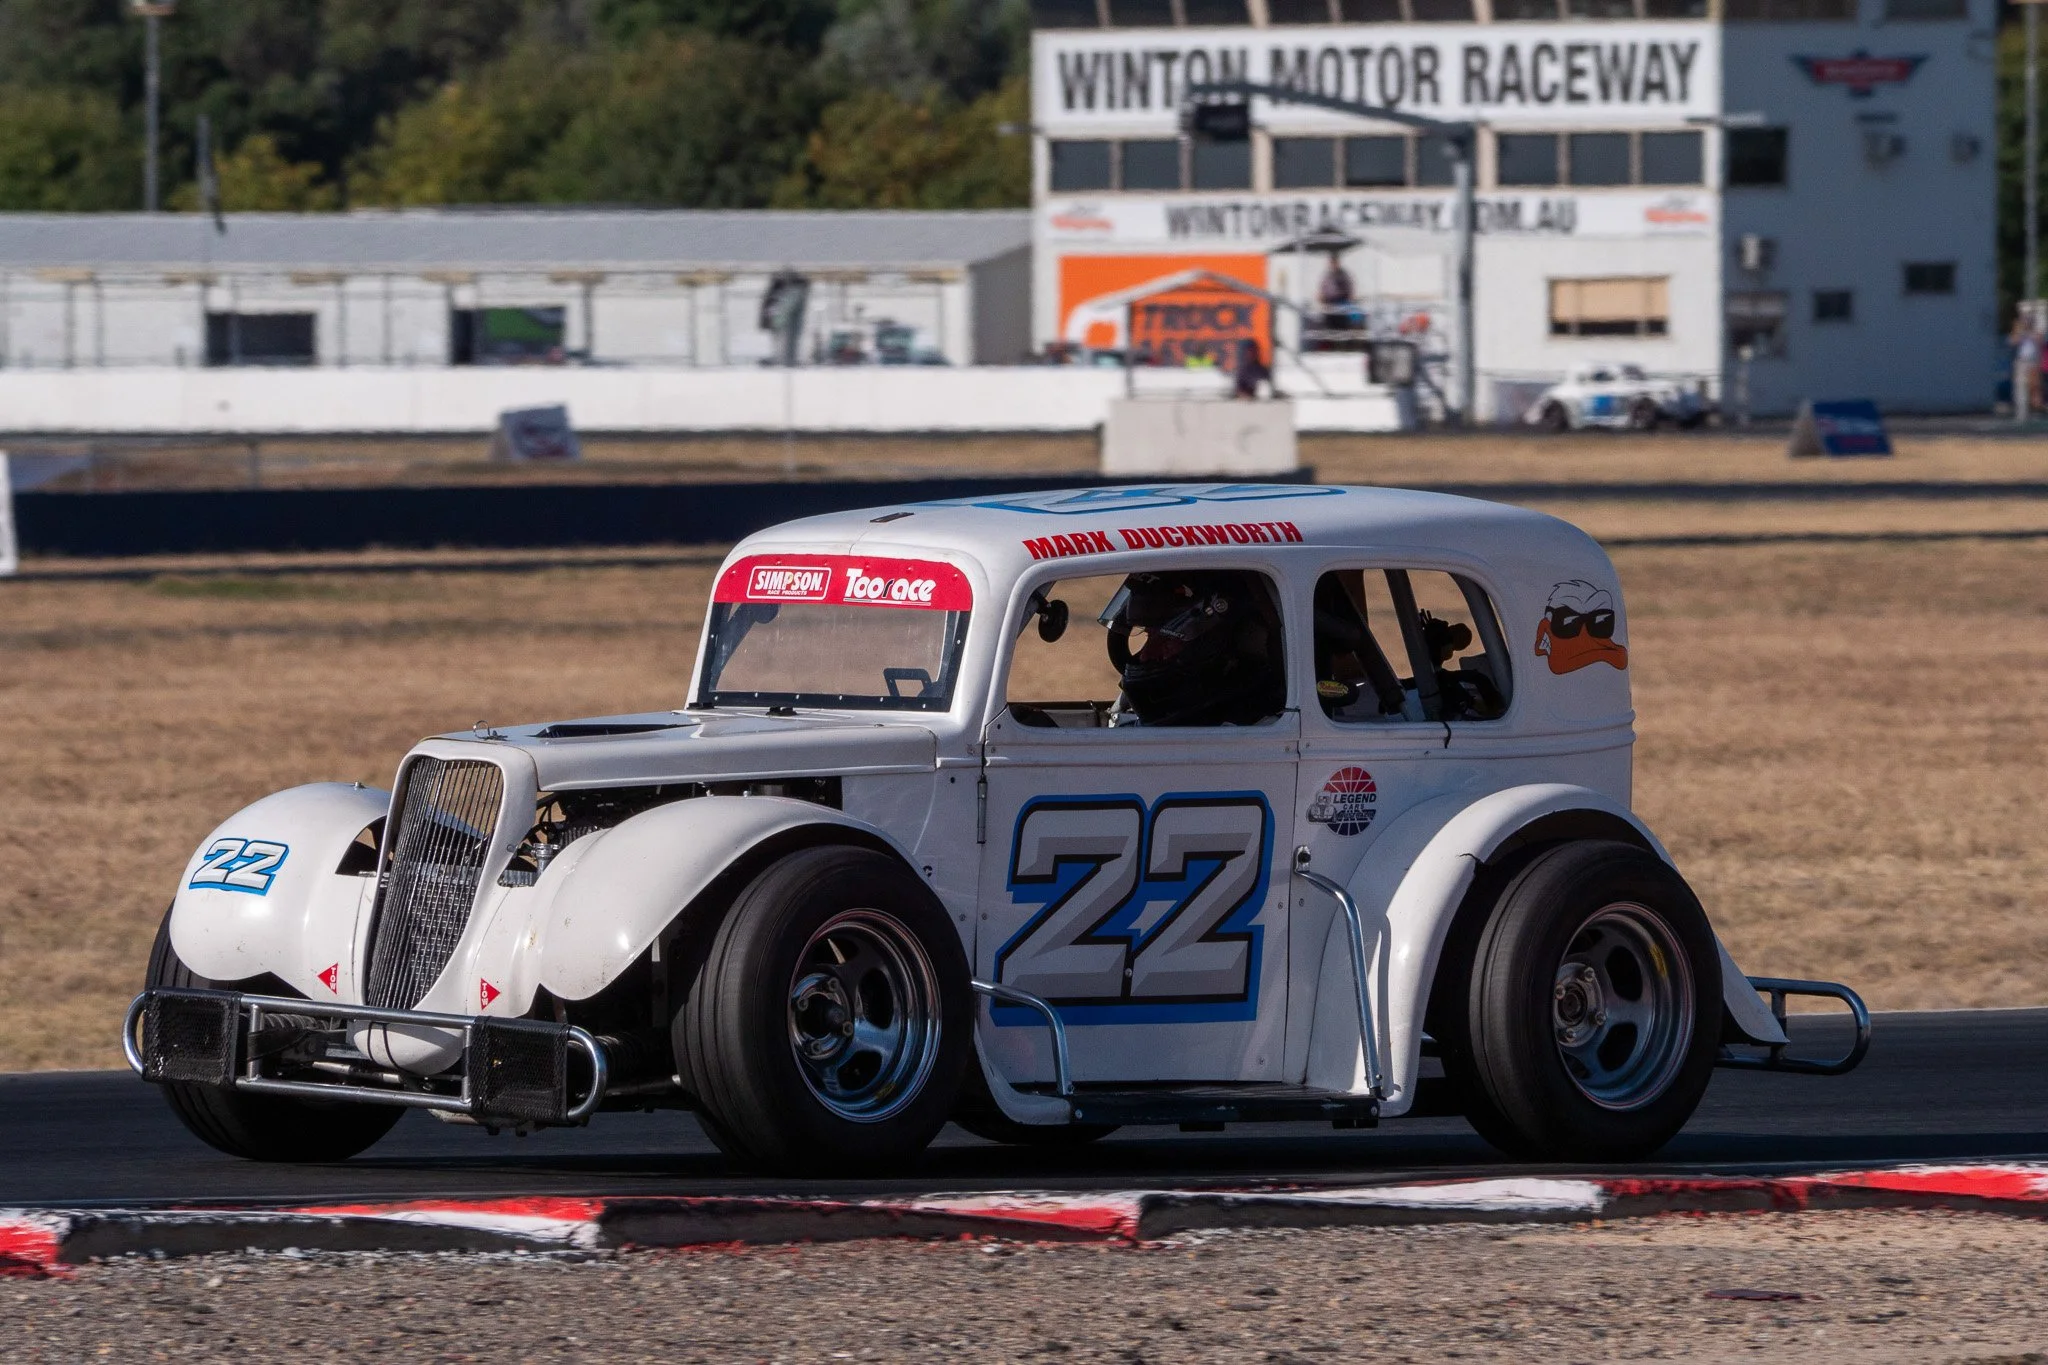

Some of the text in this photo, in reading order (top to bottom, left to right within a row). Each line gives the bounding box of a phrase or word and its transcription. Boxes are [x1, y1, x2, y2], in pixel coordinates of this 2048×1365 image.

[1057, 42, 1698, 109] WINTON MOTOR RACEWAY
[1166, 199, 1578, 238] WINTONRACEWAY.OM.AU
[1021, 521, 1304, 560] MARK DUCKWORTH
[755, 571, 823, 592] SIMPSON
[1333, 793, 1377, 804] LEGEND
[189, 838, 290, 896] 22
[990, 790, 1276, 1027] 22
[481, 982, 489, 1007] TOW
